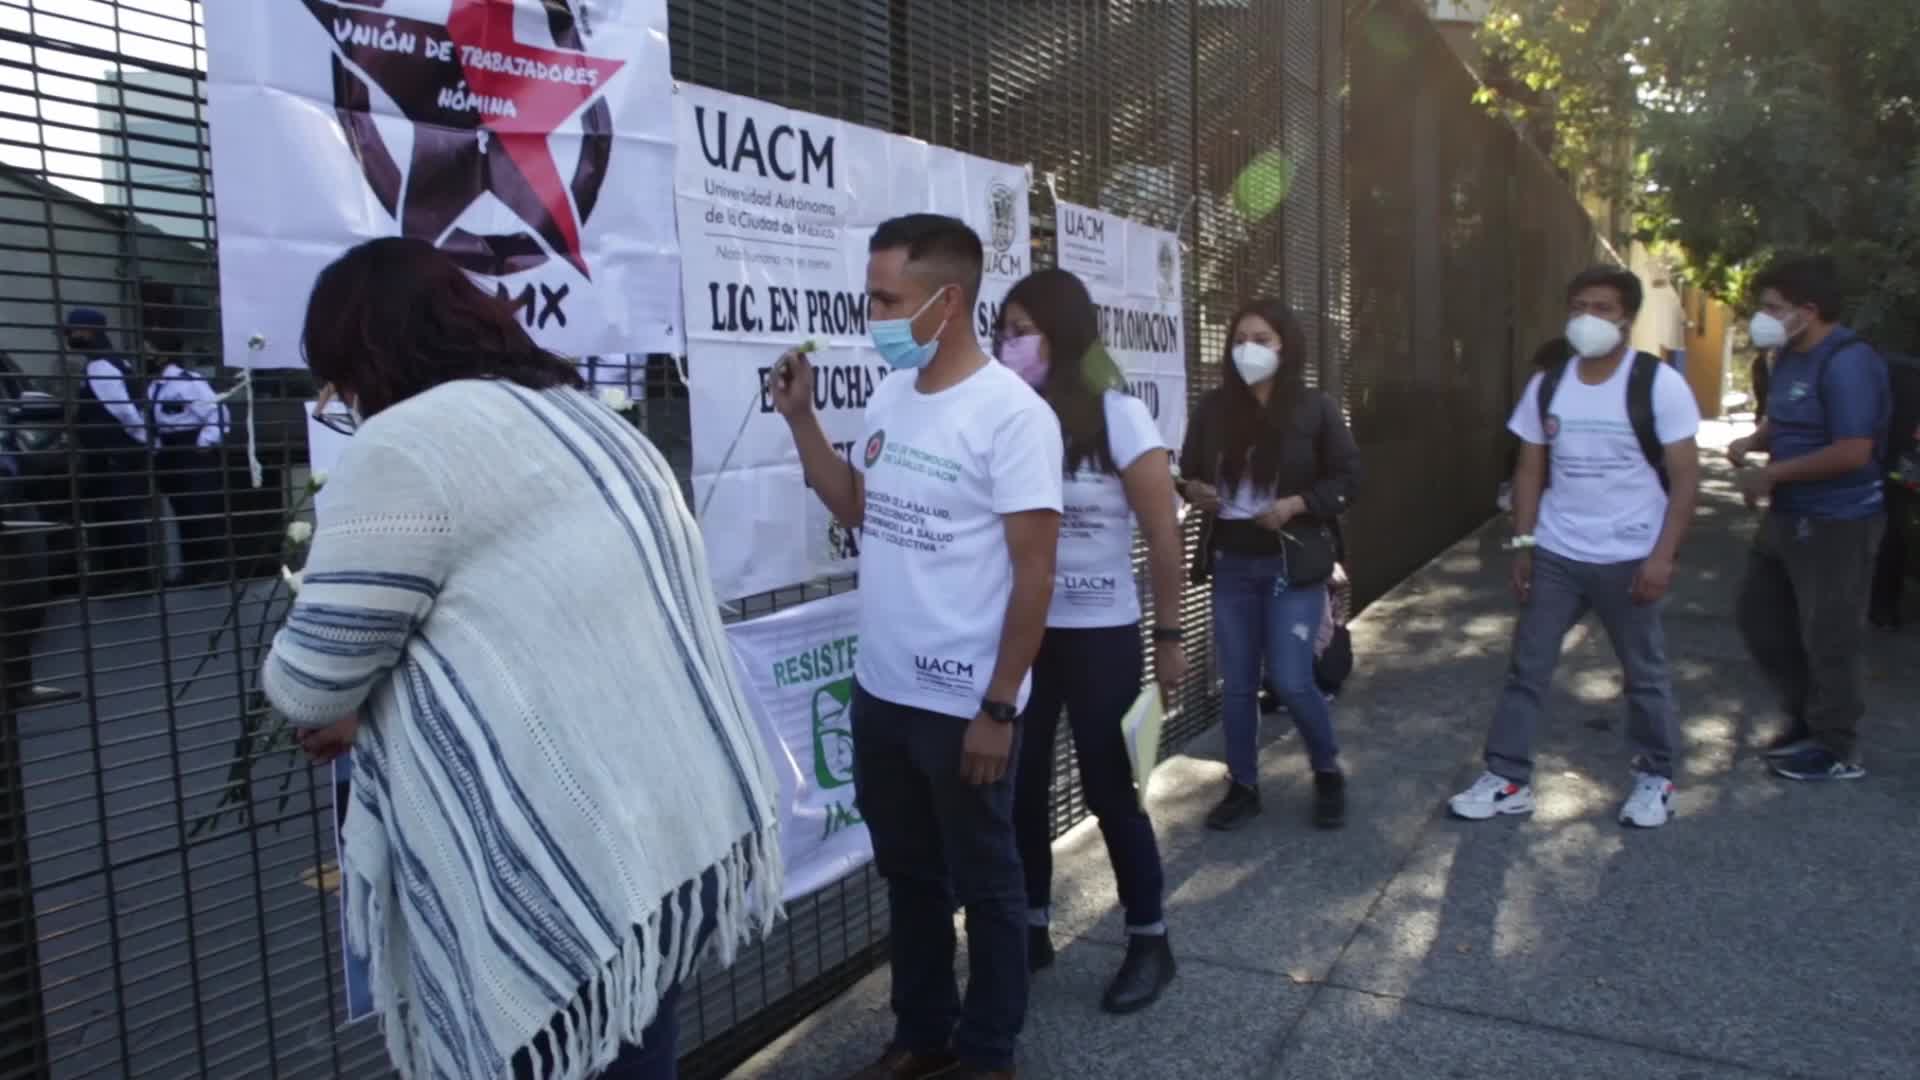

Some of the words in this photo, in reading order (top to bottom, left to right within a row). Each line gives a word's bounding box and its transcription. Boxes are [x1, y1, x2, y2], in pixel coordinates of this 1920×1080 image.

[333, 18, 416, 53] UNIÓN
[425, 37, 454, 61] DE
[461, 45, 599, 86] TRABAJADORES
[437, 81, 517, 118] NÓMINA
[694, 105, 835, 189] UACM
[704, 205, 724, 224] de
[1065, 210, 1104, 244] UACM
[984, 252, 1022, 277] UACM
[498, 276, 570, 330] MX
[709, 281, 763, 333] LIC.
[768, 285, 799, 334] EN
[807, 289, 869, 336] PROM
[812, 365, 874, 411] UCHA
[1064, 576, 1115, 591] UACM
[915, 655, 973, 678] UACM
